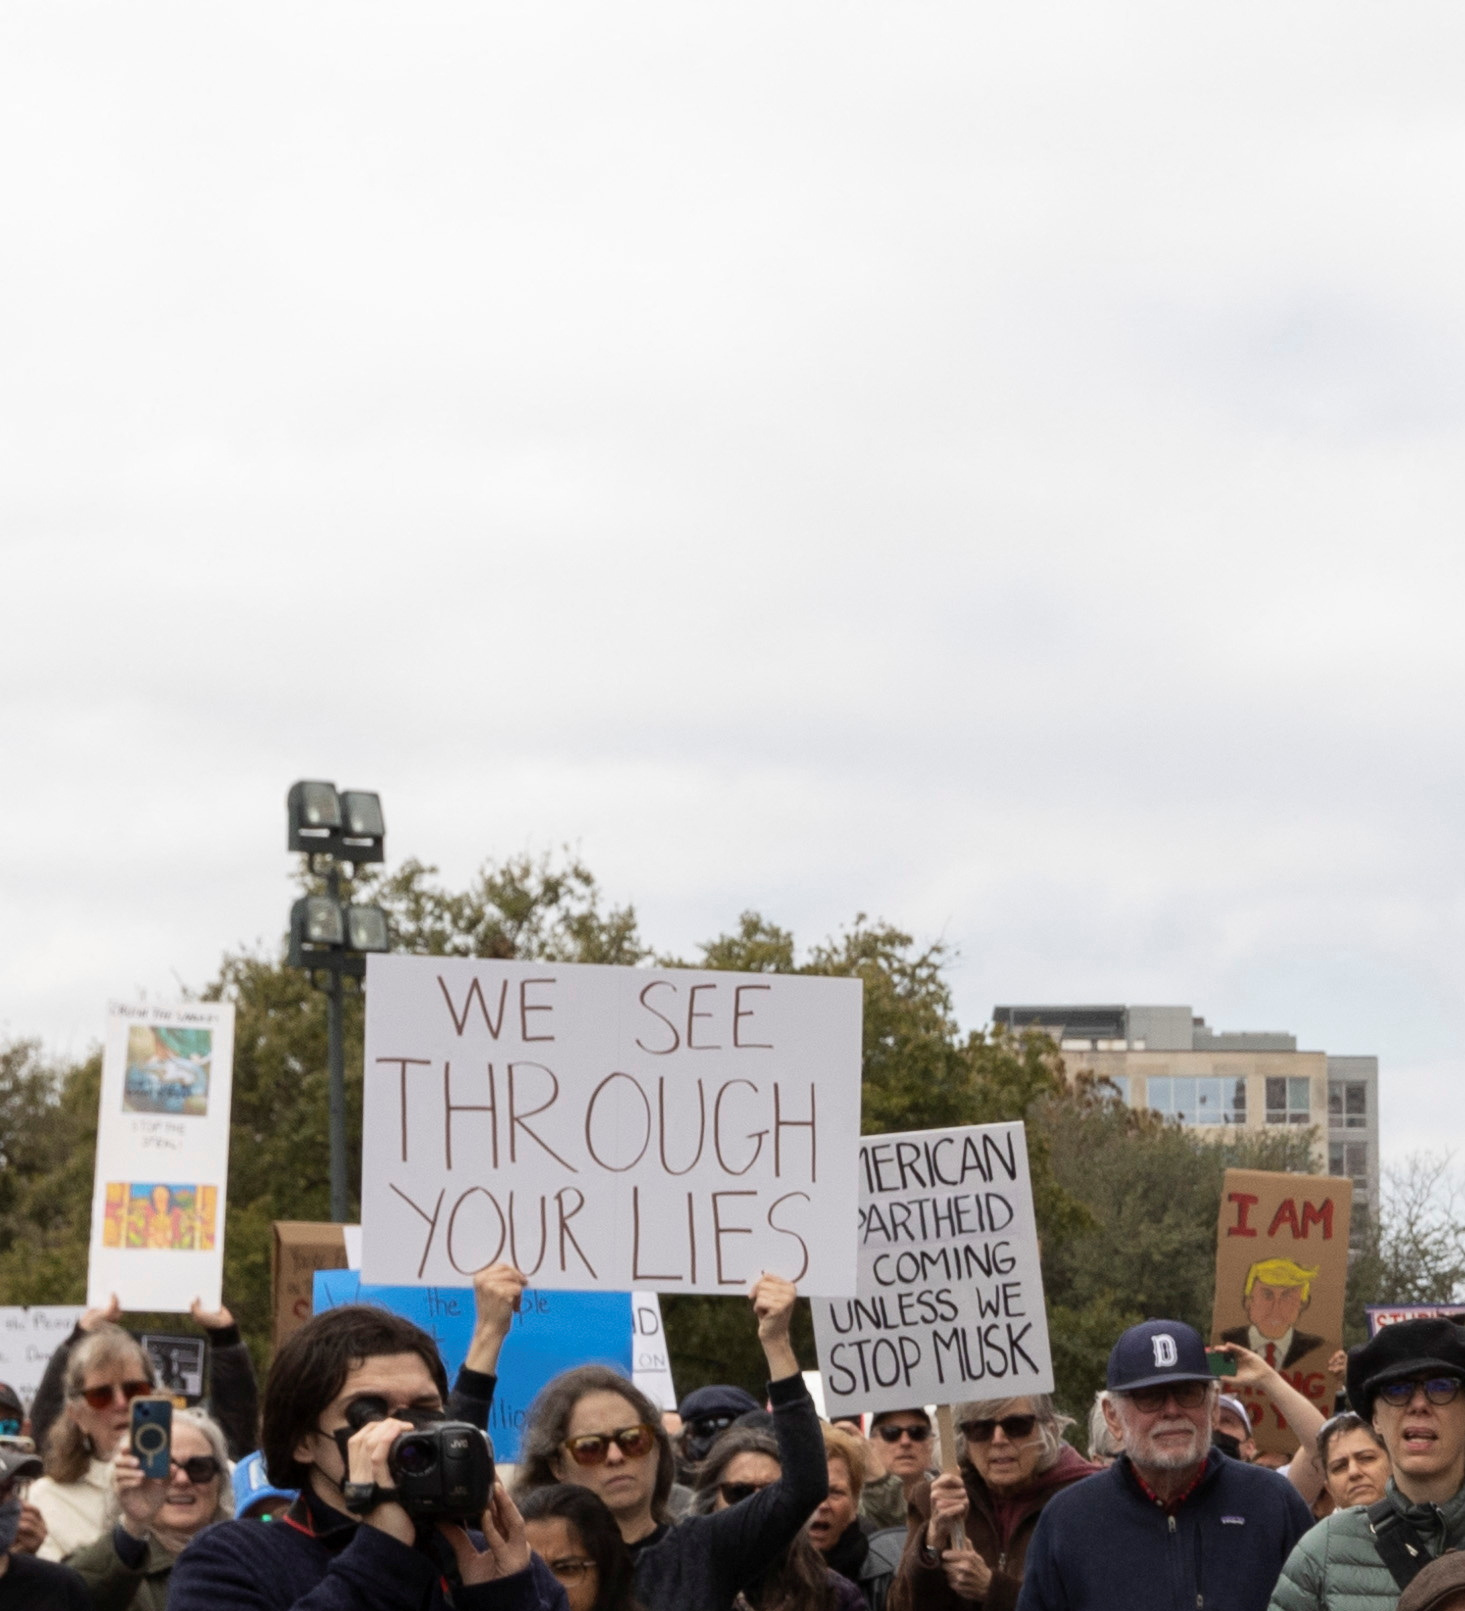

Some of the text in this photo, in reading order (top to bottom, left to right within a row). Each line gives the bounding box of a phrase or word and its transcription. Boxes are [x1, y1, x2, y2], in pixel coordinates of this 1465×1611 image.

[438, 975, 773, 1055] WE SEE
[375, 1058, 816, 1183] THROUGH
[389, 1183, 811, 1285] YOUR LIES
[1228, 1192, 1335, 1240] I AM
[873, 1241, 1016, 1286] COMING
[829, 1282, 1026, 1334] UNLESS WE
[828, 1322, 1040, 1396] STOP MUSK
[1151, 1334, 1178, 1367] D
